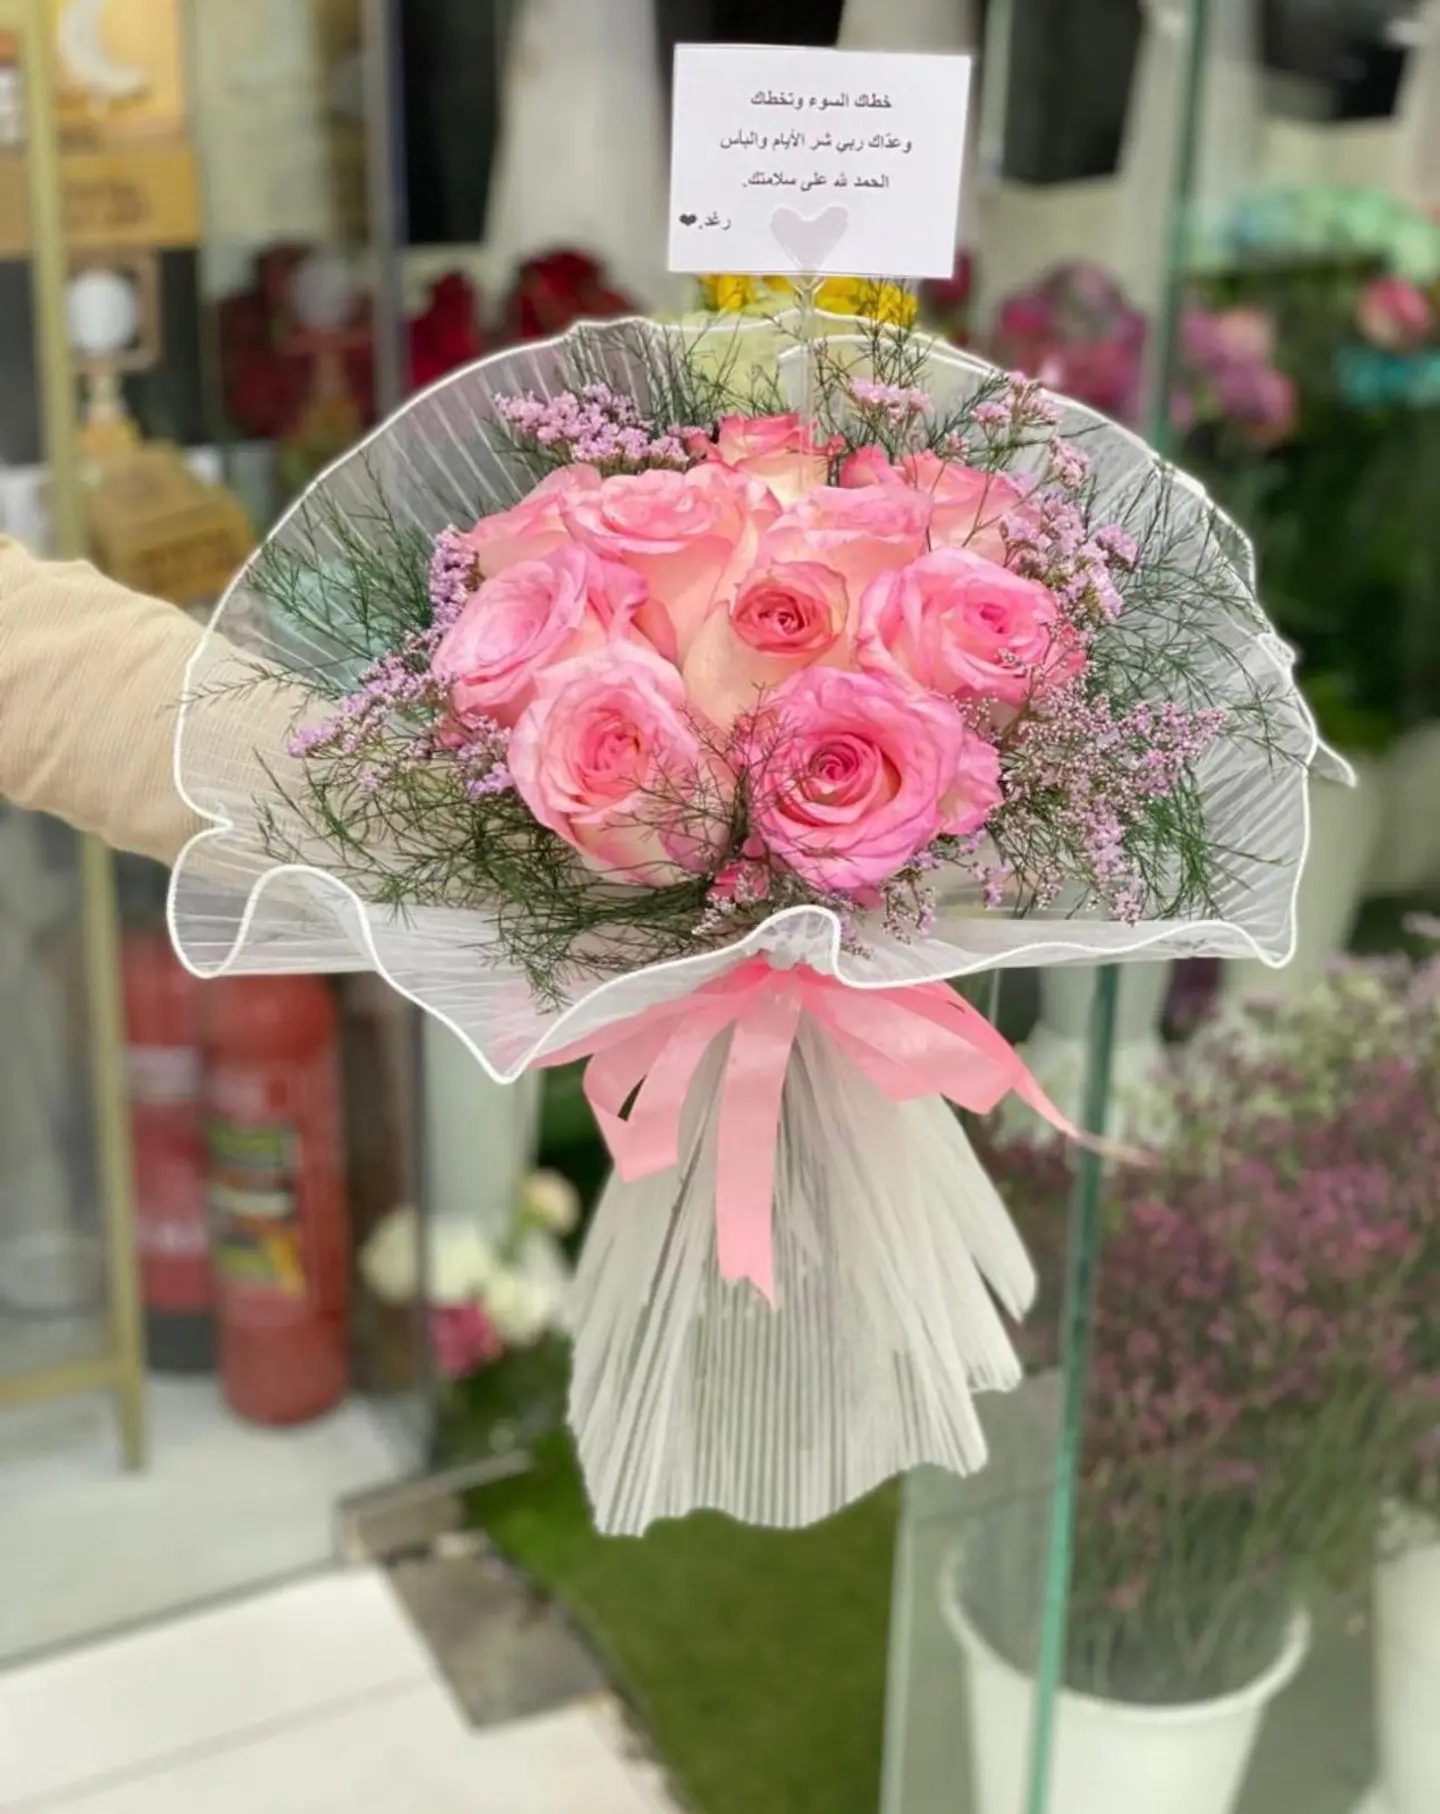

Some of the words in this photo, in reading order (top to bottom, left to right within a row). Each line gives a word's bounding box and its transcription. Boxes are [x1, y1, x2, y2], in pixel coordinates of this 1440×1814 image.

[809, 93, 849, 110] السوء
[772, 129, 805, 151] الأيام
[810, 131, 832, 150] شر
[836, 138, 863, 153] ربي
[742, 171, 797, 188] سلامتك.
[800, 172, 827, 192] على
[833, 171, 847, 187] لله
[854, 174, 889, 188] الحمد
